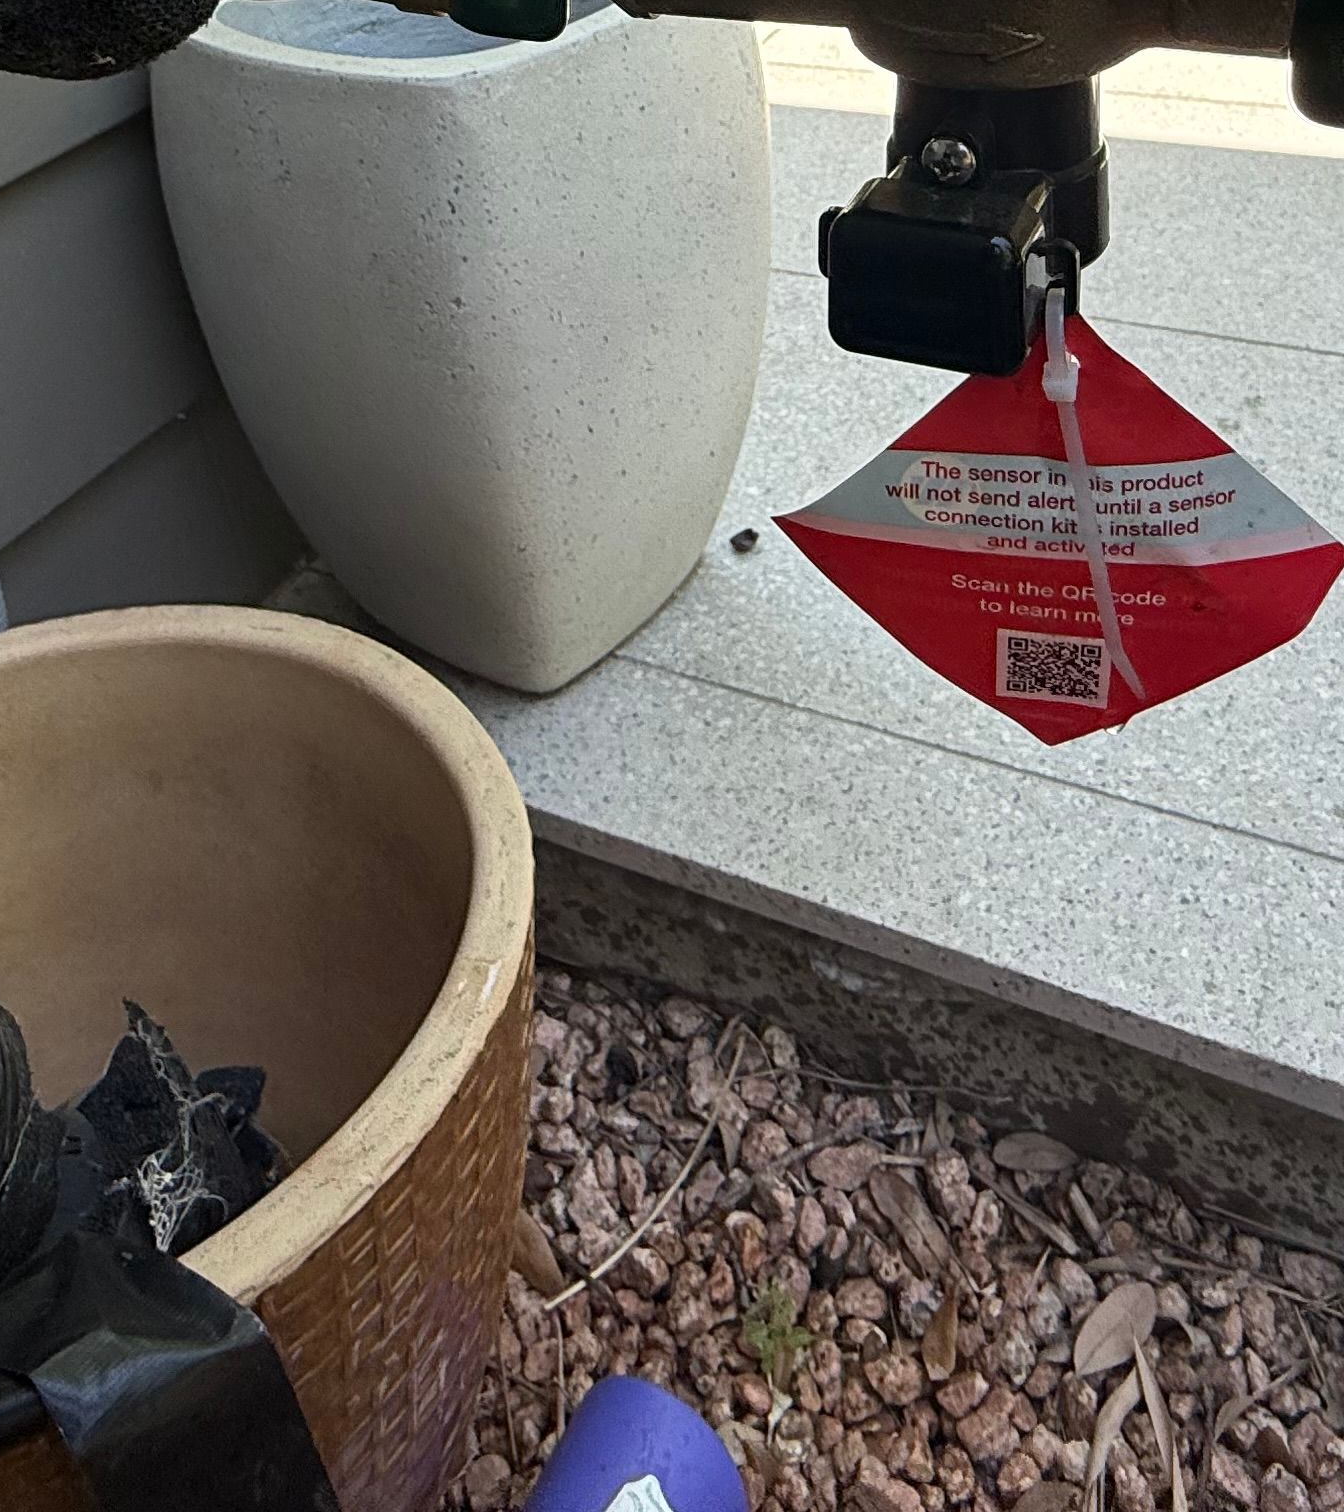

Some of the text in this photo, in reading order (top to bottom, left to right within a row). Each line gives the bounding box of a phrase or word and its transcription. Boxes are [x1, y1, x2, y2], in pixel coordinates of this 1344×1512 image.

[921, 461, 961, 480] The
[968, 467, 1042, 484] sensor
[1047, 467, 1067, 486] in
[1121, 470, 1205, 496] product
[885, 483, 1236, 515] will not send alert until a sensor
[924, 510, 1044, 533] connection
[1051, 517, 1078, 535] kit
[1109, 517, 1200, 537] installed
[987, 536, 1136, 557] and activted
[951, 574, 1009, 595] Scan
[1017, 581, 1055, 598] the
[979, 598, 1135, 626] to learn me
